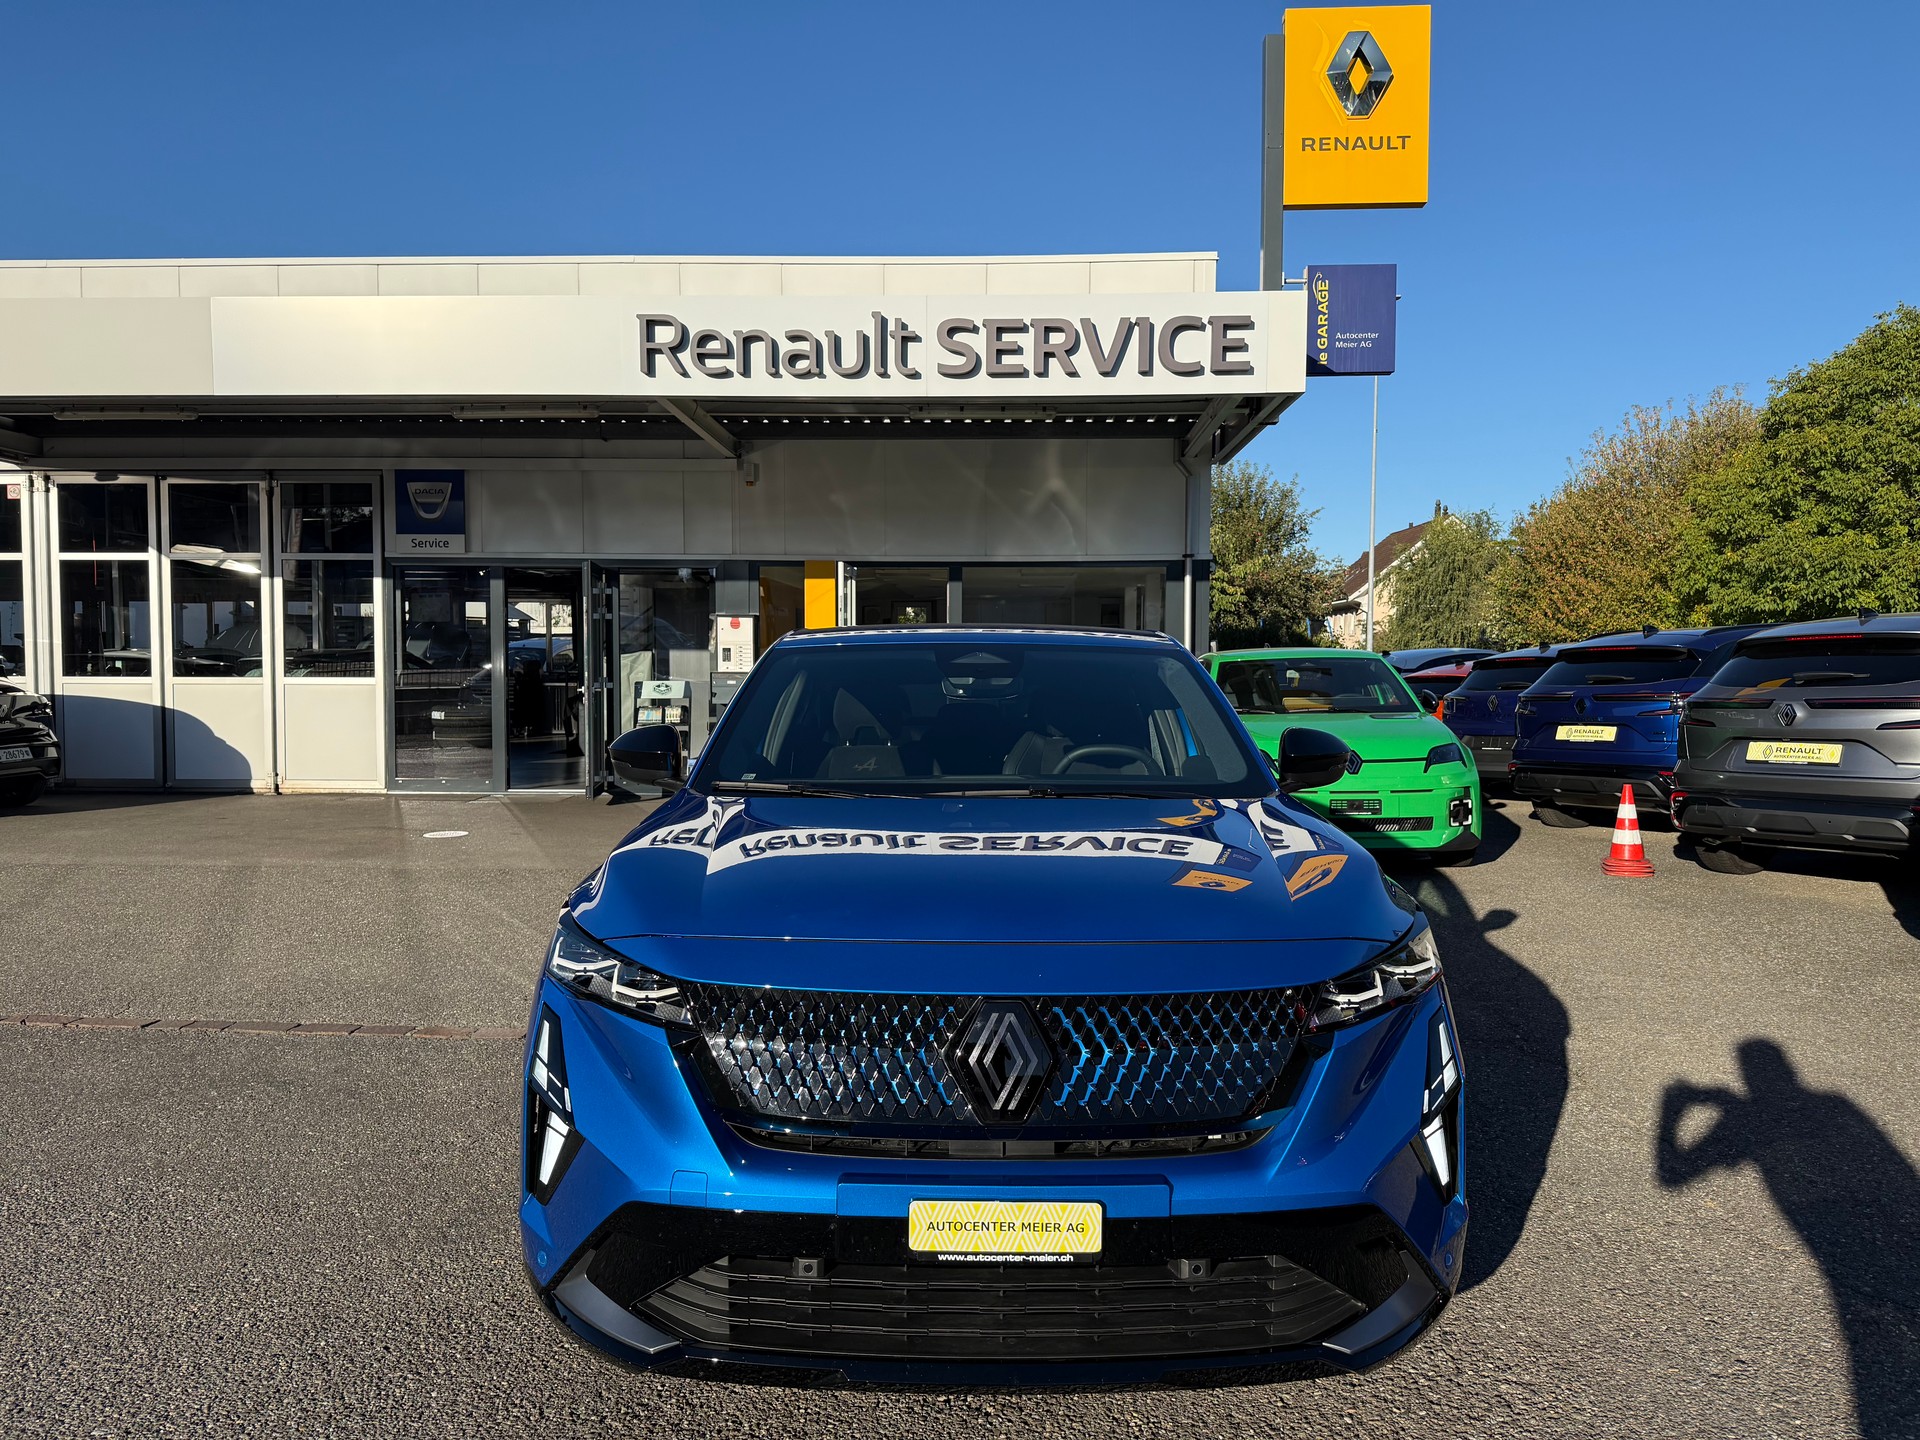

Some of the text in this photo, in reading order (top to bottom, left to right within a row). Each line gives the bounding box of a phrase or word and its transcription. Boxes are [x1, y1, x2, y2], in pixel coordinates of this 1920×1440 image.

[1301, 135, 1411, 152] RENAULT
[1317, 279, 1329, 365] le GARAGE
[636, 311, 1254, 379] Renault SERVICE
[411, 538, 450, 548] Service
[1775, 746, 1823, 755] RENAULT
[926, 1221, 1085, 1233] AUTOCENTER MEIER AG
[938, 1253, 1074, 1262] www.autocenter-meier.ch
